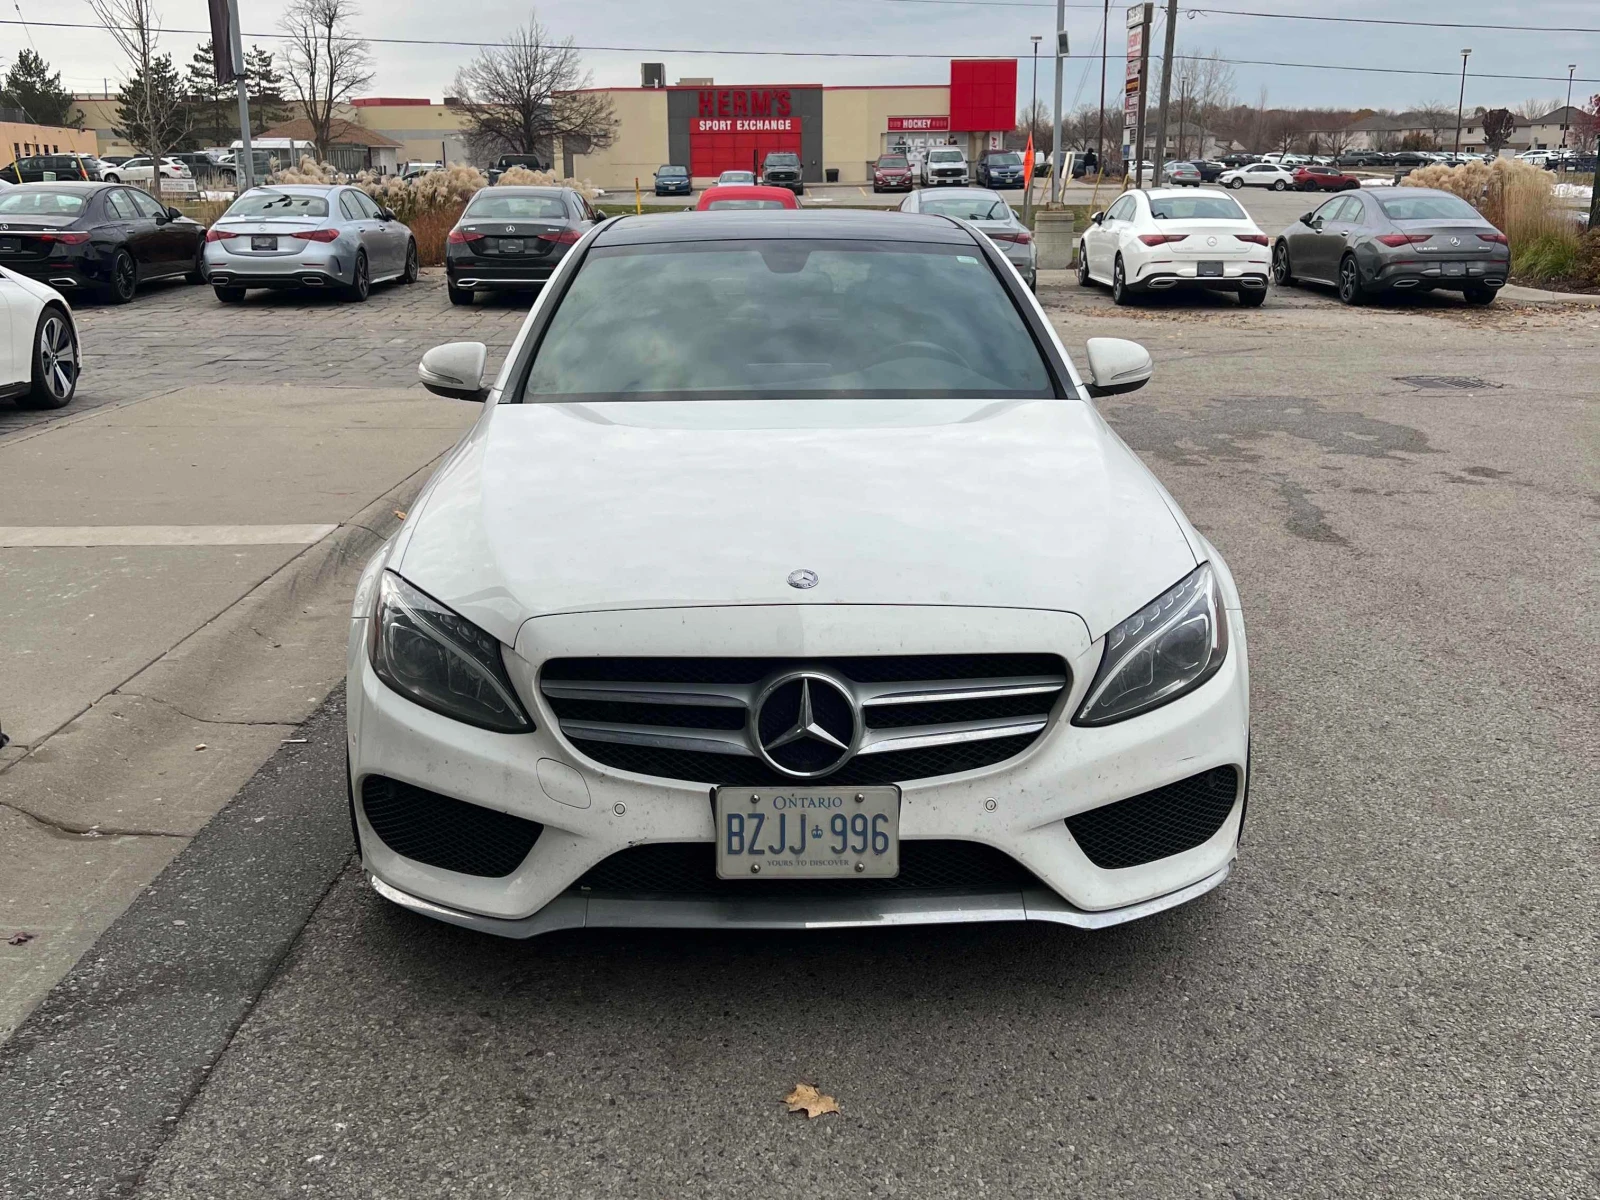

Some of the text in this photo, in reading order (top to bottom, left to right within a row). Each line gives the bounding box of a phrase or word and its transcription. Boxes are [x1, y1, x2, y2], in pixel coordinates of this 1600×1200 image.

[698, 90, 792, 116] HERM'S
[699, 119, 792, 131] SPORT EXCHANGE
[902, 119, 932, 129] HOCKEY
[773, 795, 843, 810] ONTARIO
[727, 813, 889, 855] BZJJ 996
[809, 859, 850, 867] DISCOVER
